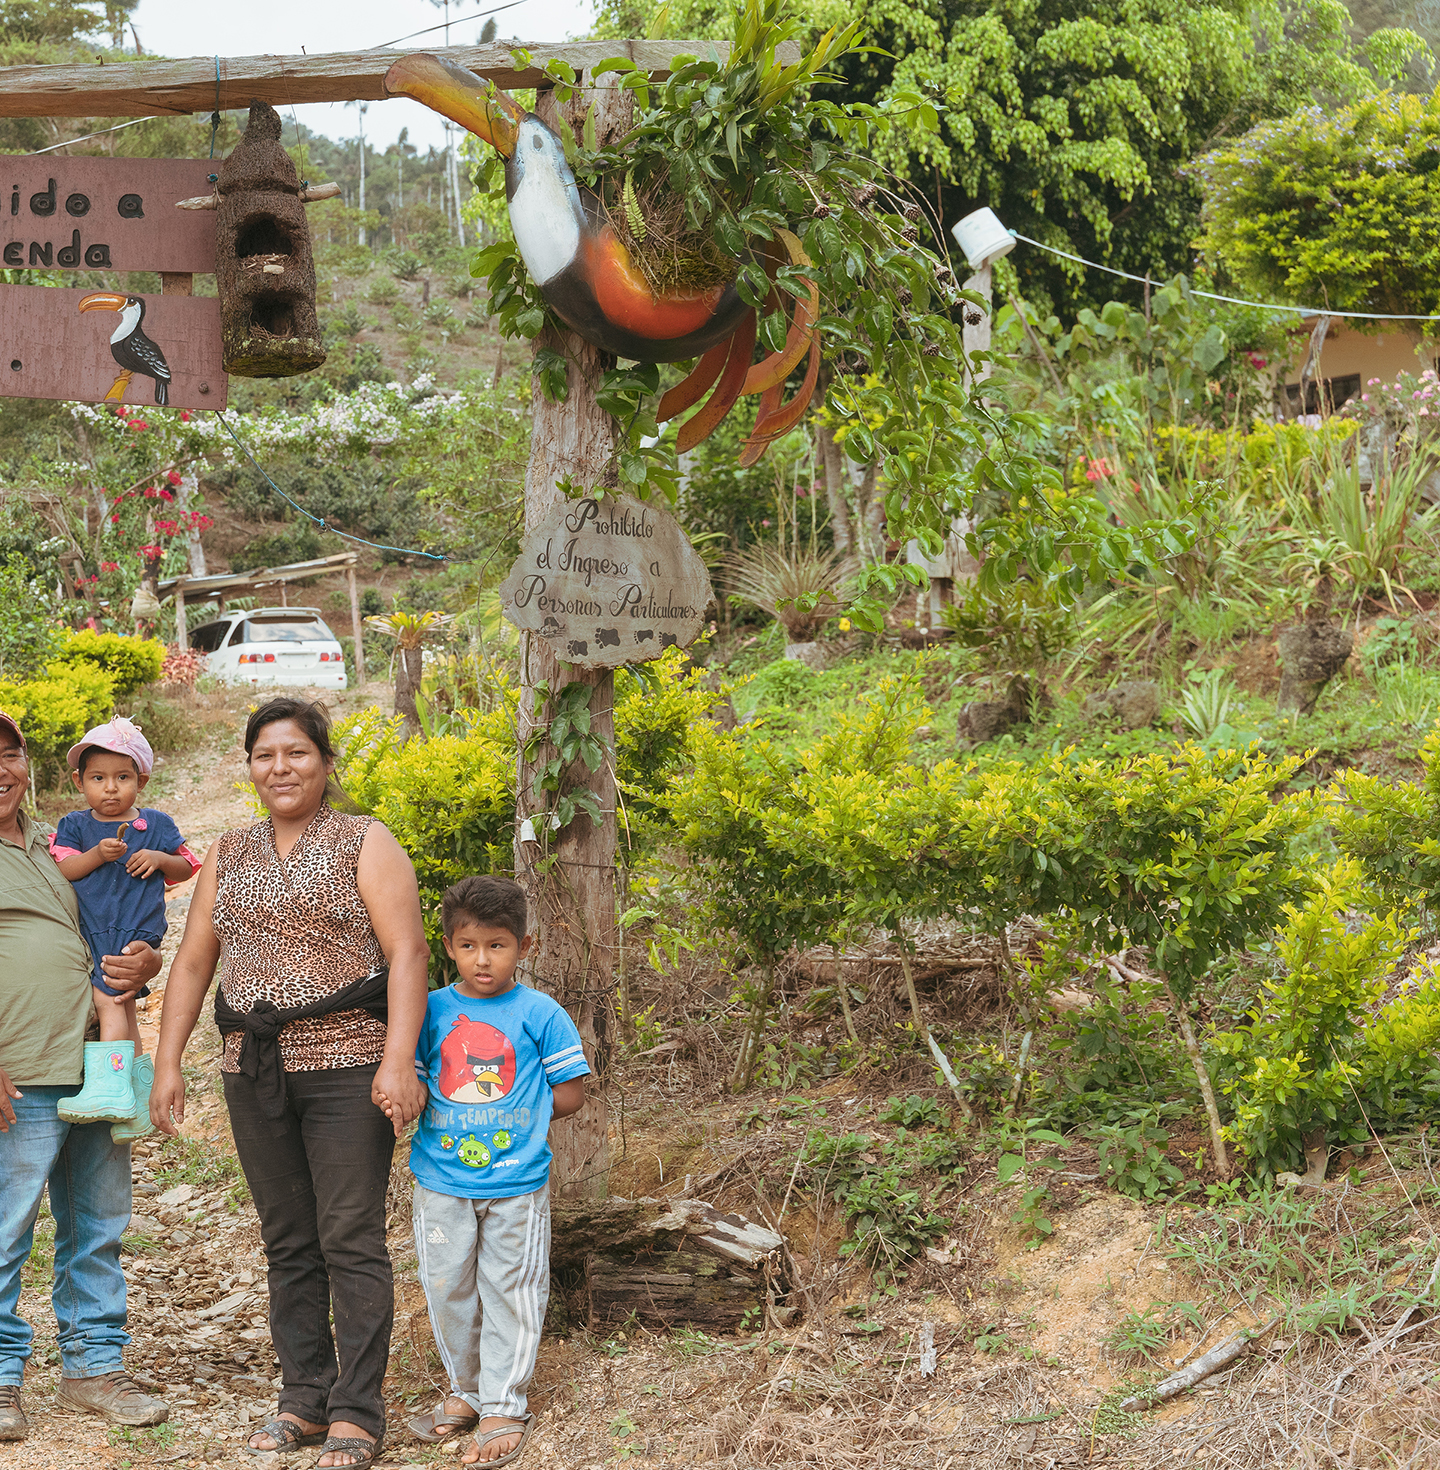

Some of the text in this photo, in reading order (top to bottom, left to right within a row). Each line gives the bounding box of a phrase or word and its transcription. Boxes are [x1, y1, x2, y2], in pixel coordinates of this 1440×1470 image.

[117, 192, 145, 219] a
[565, 498, 655, 538] Prohibido
[536, 538, 661, 587] el Ingreso a
[514, 574, 697, 619] Personas Particulares
[458, 1107, 531, 1130] TEMPERED
